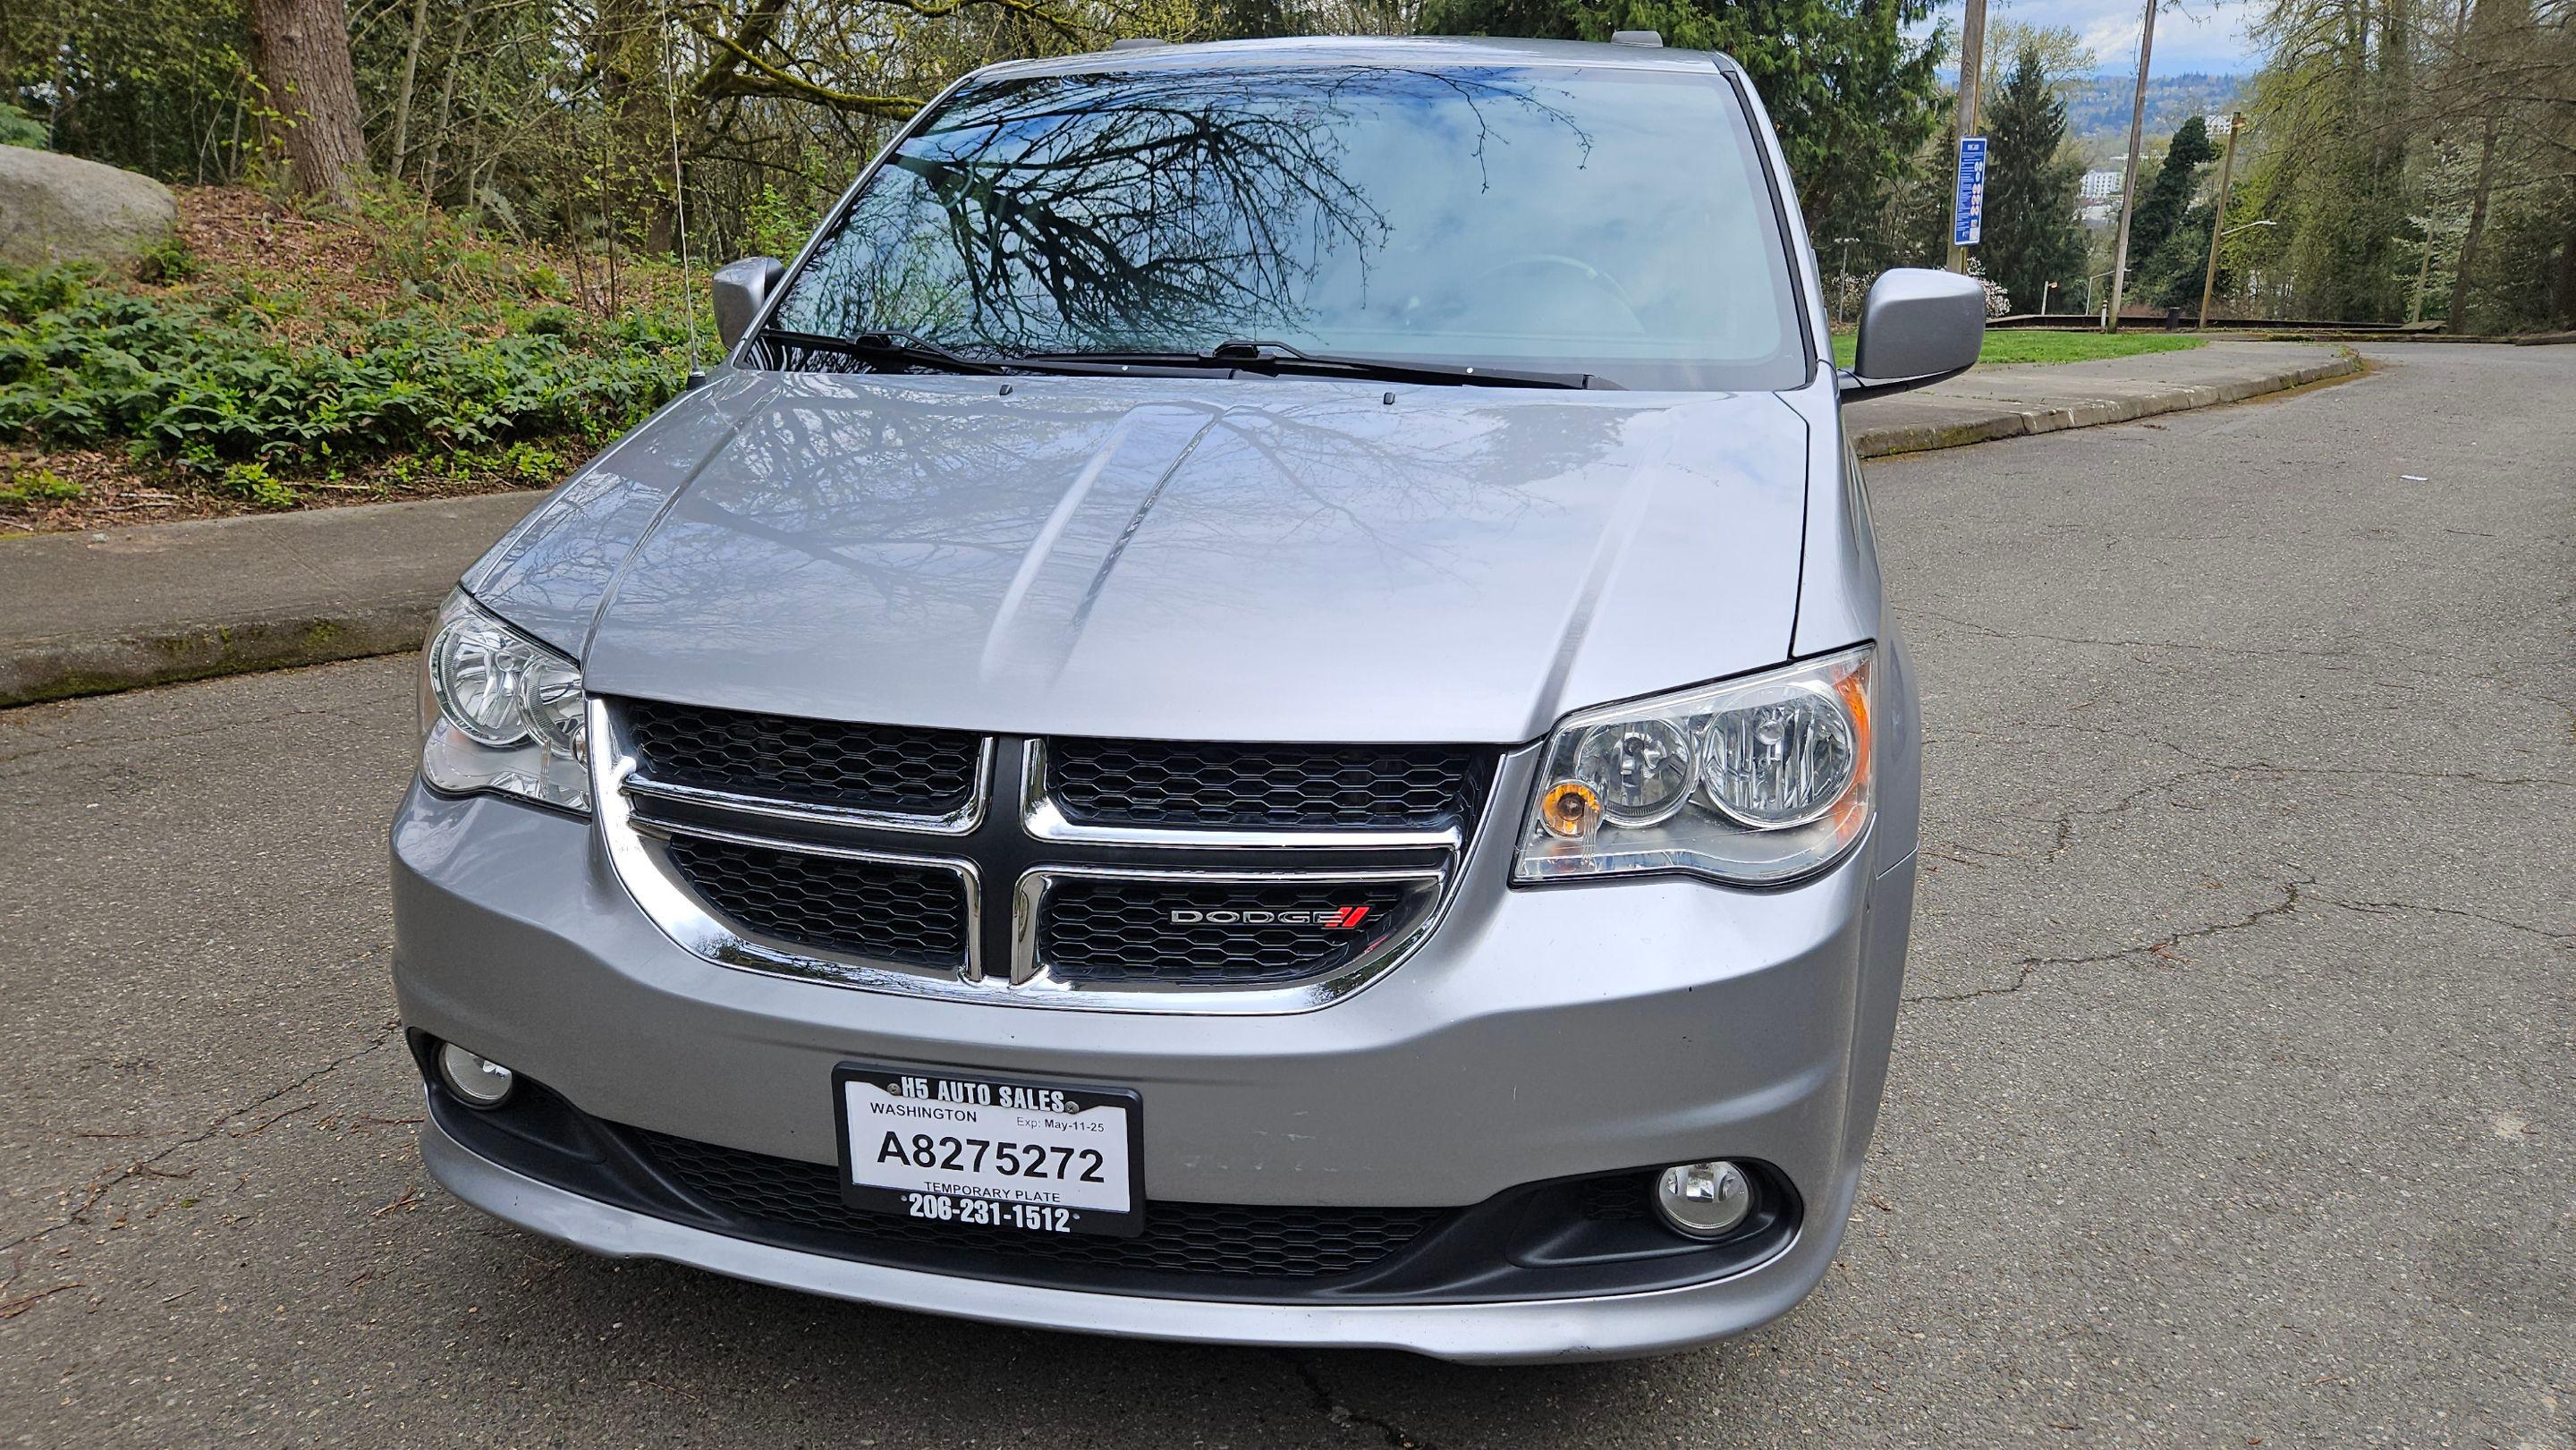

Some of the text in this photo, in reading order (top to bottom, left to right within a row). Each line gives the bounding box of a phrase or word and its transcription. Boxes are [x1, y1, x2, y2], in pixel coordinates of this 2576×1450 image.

[1171, 910, 1343, 924] DODGE
[901, 1076, 1065, 1113] H5 AUTO SALES
[870, 1102, 977, 1123] WASHINGTON
[1017, 1116, 1105, 1132] Exp: May-11-25
[877, 1130, 1105, 1183] A8275272
[924, 1181, 1061, 1203] TEMPORARY PLATE
[910, 1192, 1071, 1233] 206-231-1512
